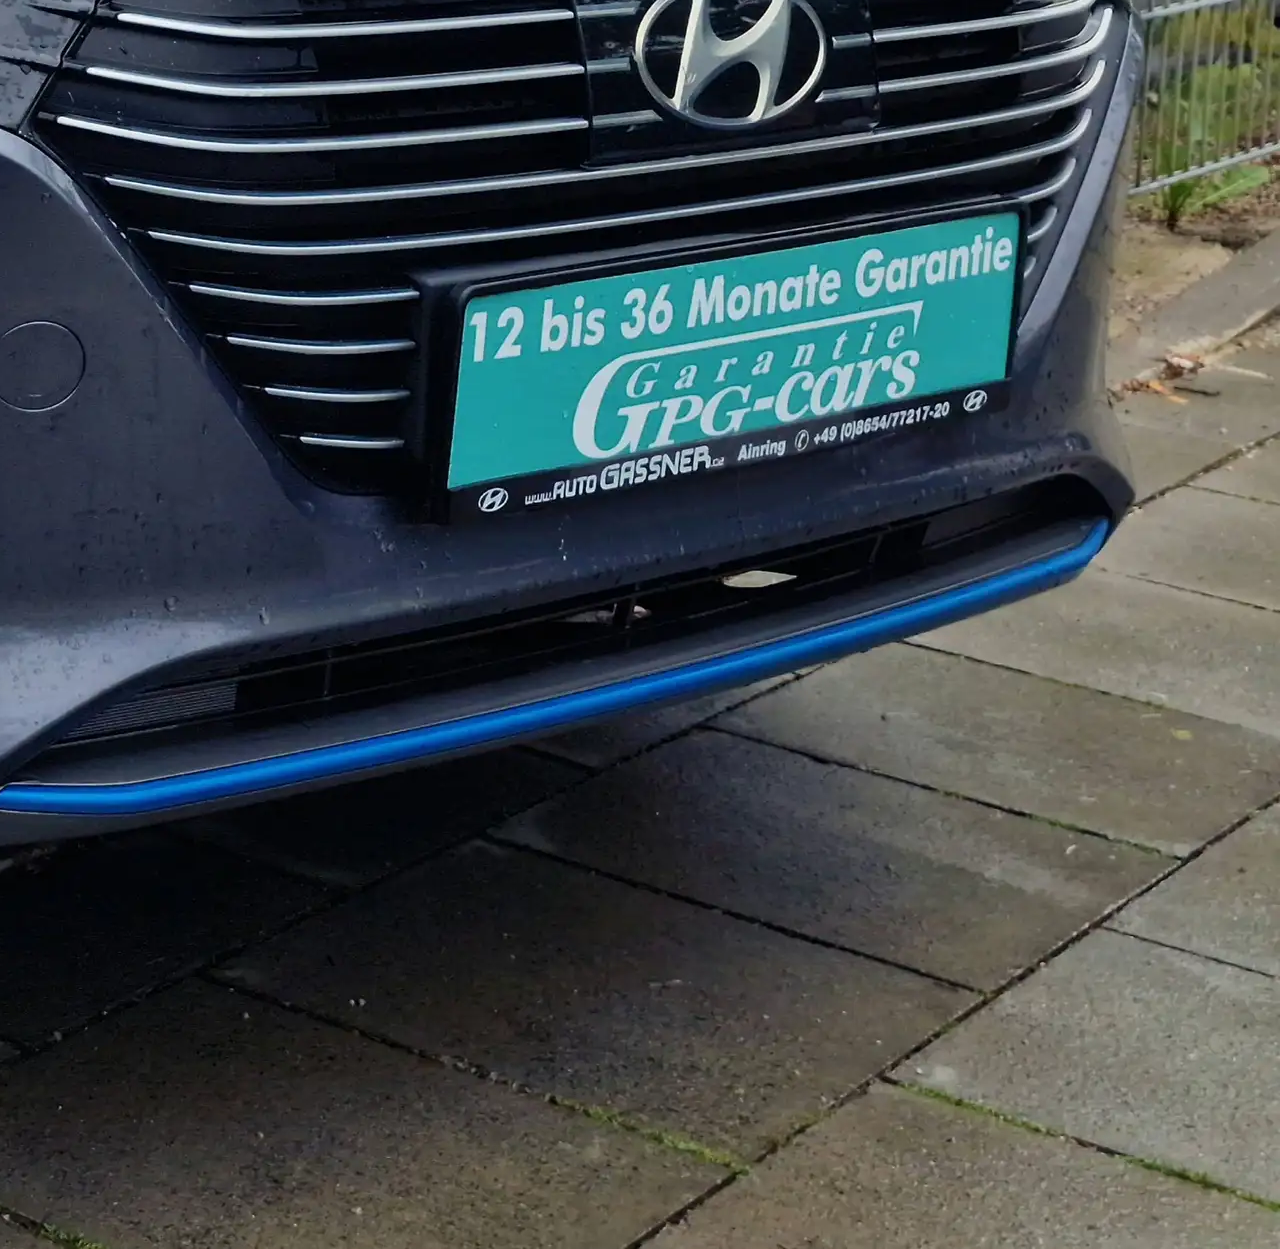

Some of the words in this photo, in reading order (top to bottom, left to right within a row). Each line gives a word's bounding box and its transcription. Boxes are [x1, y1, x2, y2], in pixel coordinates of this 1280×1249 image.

[470, 306, 524, 362] 12
[540, 295, 606, 352] bis
[620, 284, 673, 339] 36
[687, 263, 841, 328] Monate
[855, 226, 1013, 298] Garantie
[626, 321, 905, 398] Garantie
[737, 439, 787, 461] Ainring
[813, 425, 838, 445] +49
[840, 401, 950, 442] (0)8654/77217-20
